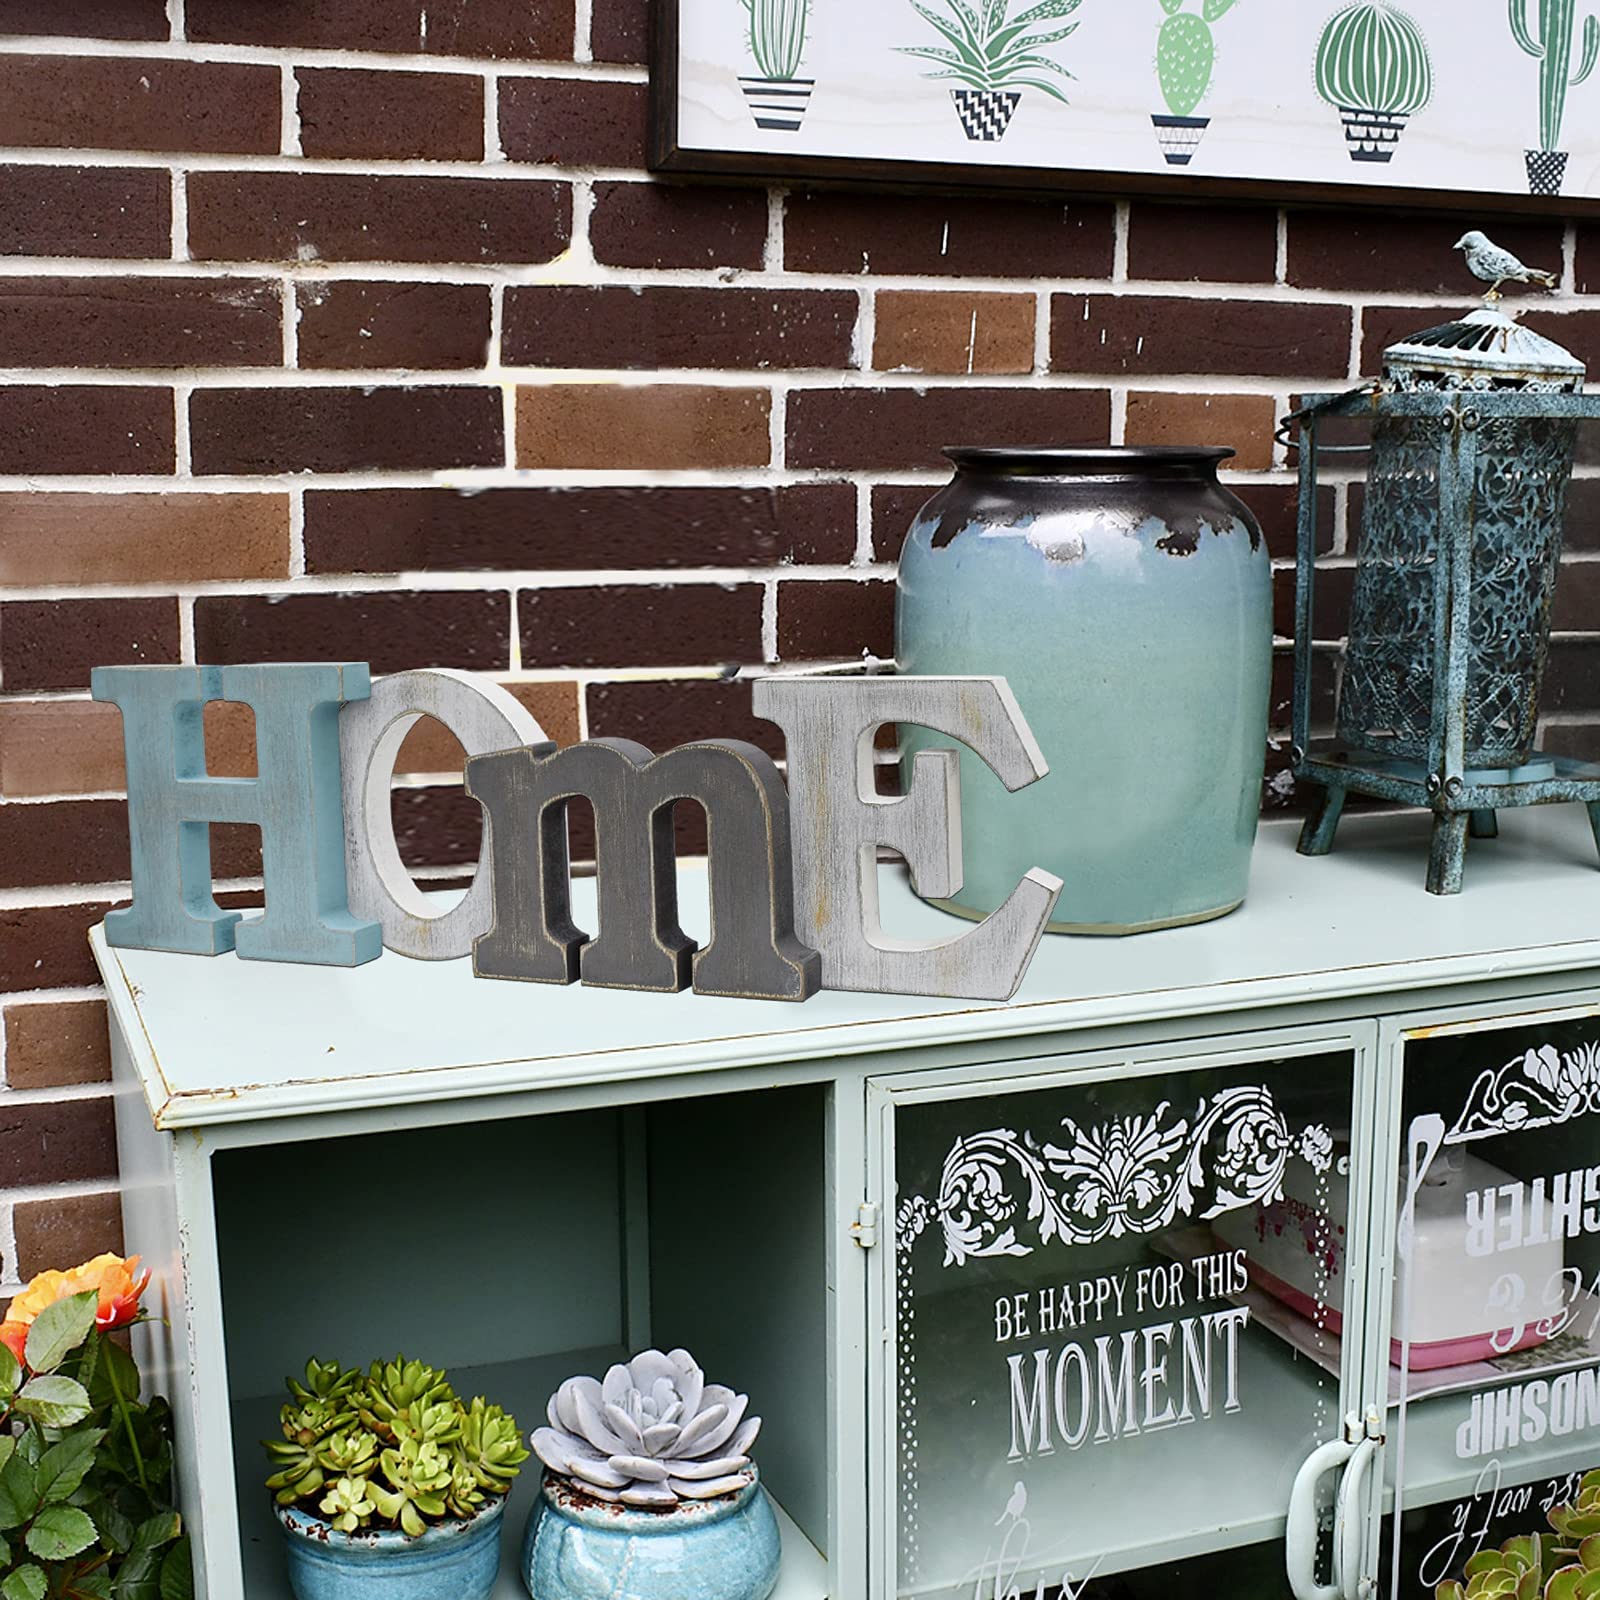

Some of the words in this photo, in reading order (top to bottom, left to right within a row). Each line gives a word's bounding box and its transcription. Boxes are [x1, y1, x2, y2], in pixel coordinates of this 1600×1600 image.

[994, 1293, 1031, 1342] BE
[1039, 1266, 1130, 1335] HAPPY
[1136, 1262, 1185, 1312] FOR
[1192, 1249, 1249, 1302] THIS
[1006, 1306, 1251, 1464] MOMENT
